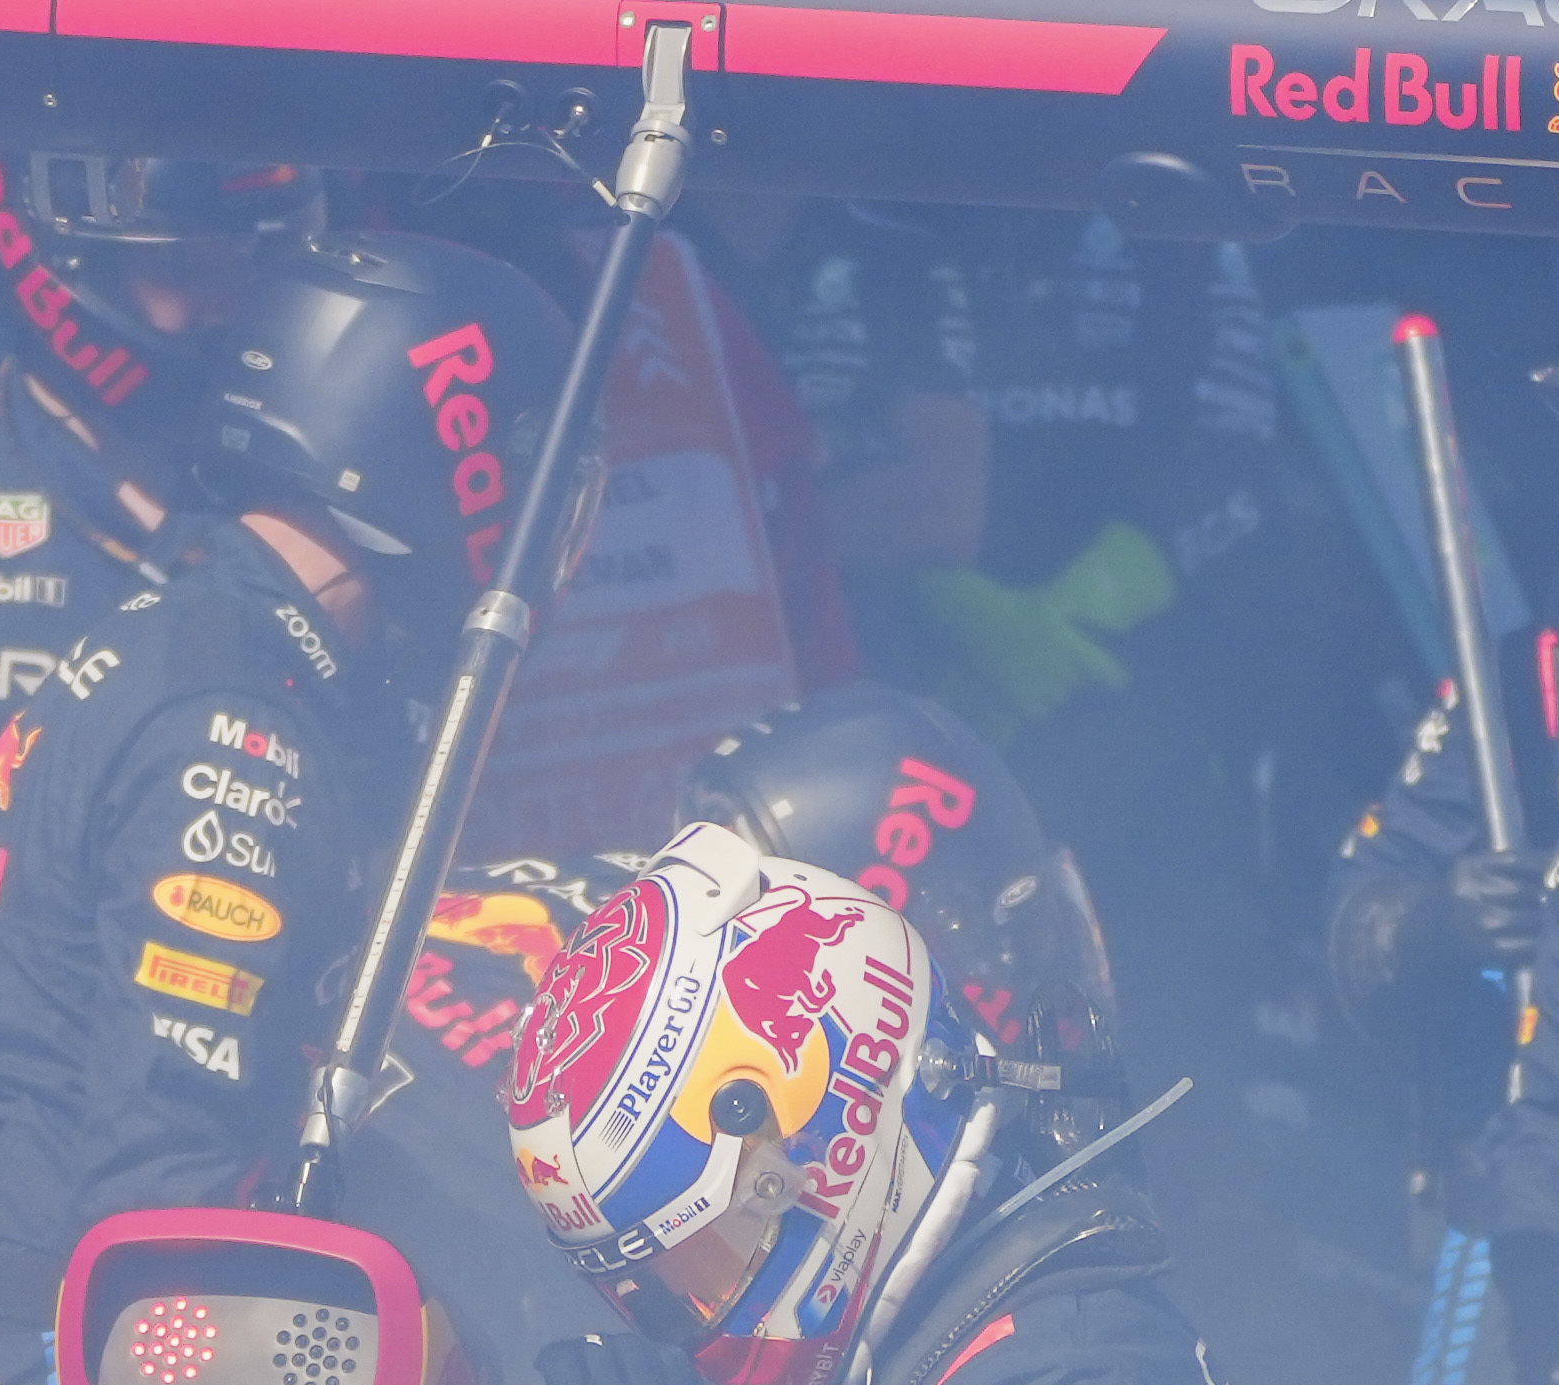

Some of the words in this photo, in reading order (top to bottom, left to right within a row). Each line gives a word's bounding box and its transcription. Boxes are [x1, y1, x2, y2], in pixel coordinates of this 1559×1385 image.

[1230, 43, 1371, 122] Red
[1384, 52, 1521, 131] Bull
[275, 605, 337, 679] zoom
[210, 713, 301, 778] Mobil
[187, 890, 265, 931] RAUCH
[620, 1014, 685, 1122] Player
[795, 1076, 884, 1219] Red
[849, 955, 916, 1092] Bull
[658, 1205, 696, 1235] Mobil
[829, 1227, 869, 1285] viaplay
